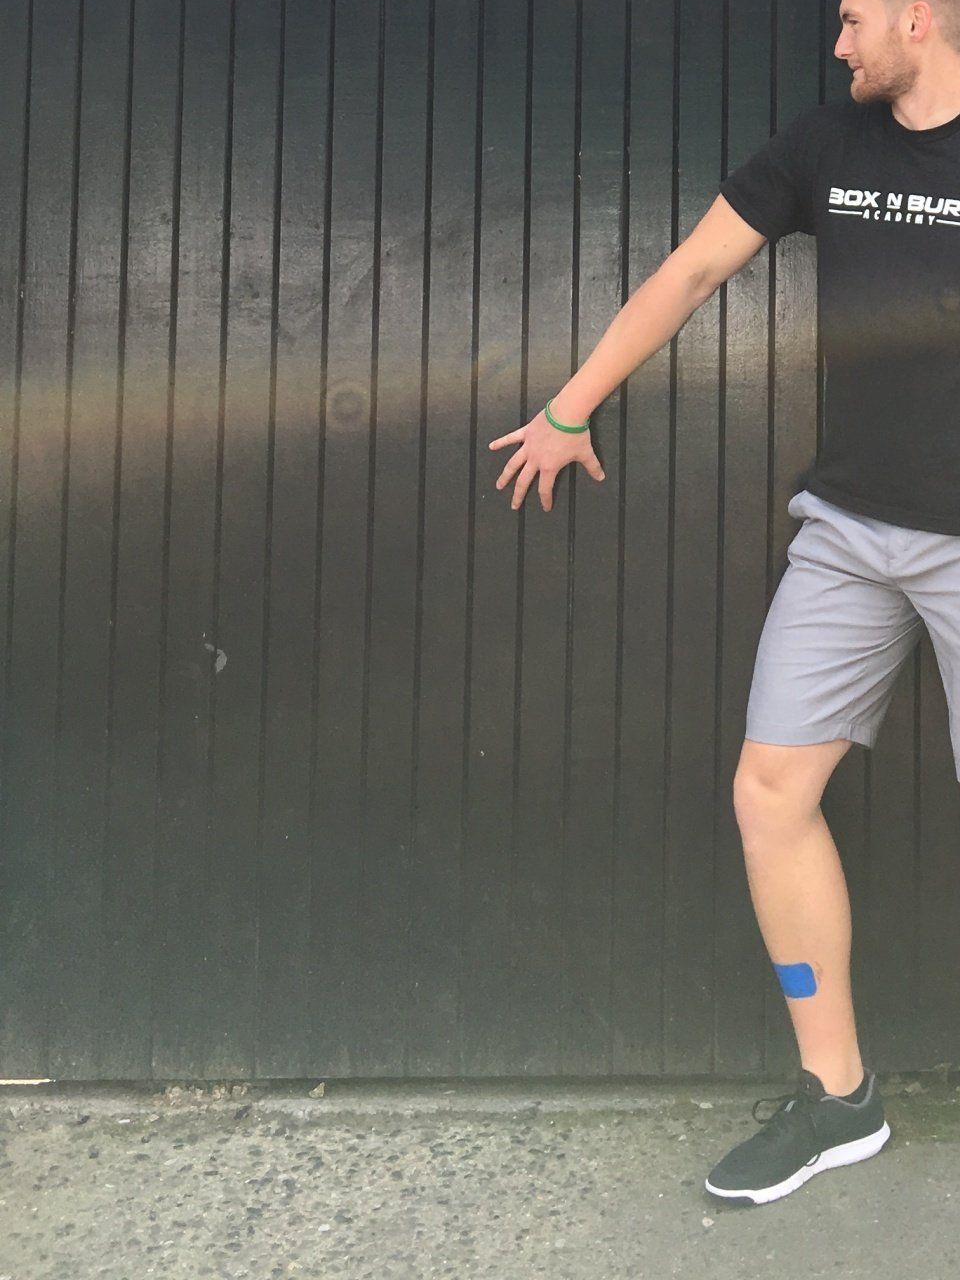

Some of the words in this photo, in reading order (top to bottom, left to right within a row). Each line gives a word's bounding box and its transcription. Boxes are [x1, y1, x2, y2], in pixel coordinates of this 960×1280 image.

[828, 187, 881, 207] BOX
[887, 193, 903, 209] N
[862, 209, 936, 225] ACADEMY
